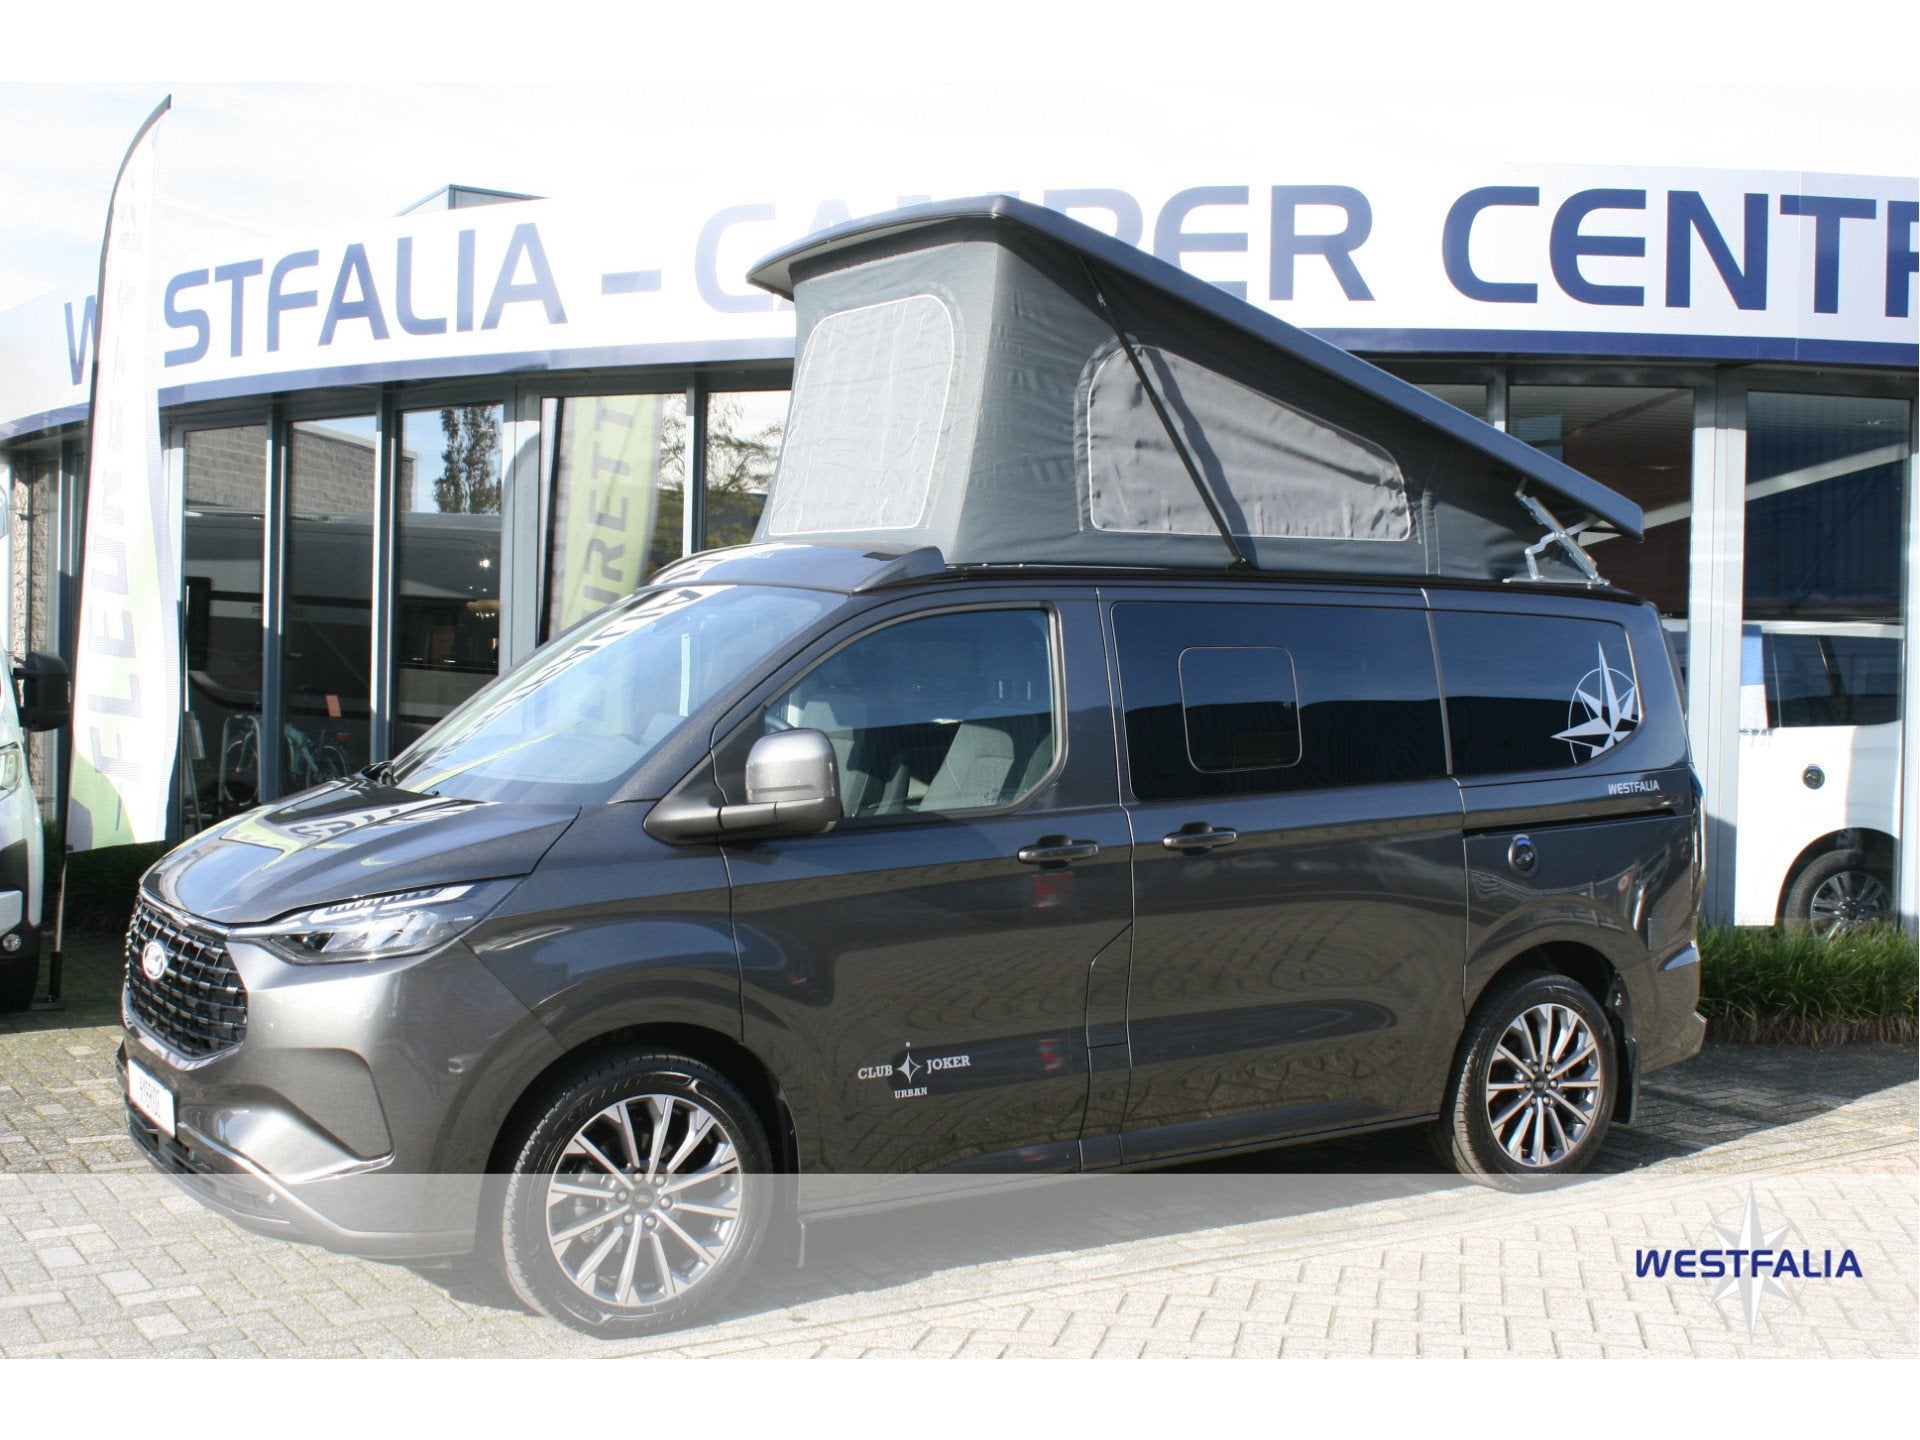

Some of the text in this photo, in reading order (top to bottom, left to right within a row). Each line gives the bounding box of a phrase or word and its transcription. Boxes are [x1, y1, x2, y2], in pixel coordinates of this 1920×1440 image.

[64, 222, 568, 386] WSTFALIA
[1608, 780, 1660, 795] WESTFALIA
[857, 1055, 971, 1080] CLUB JOKER
[894, 1086, 928, 1099] URBAN
